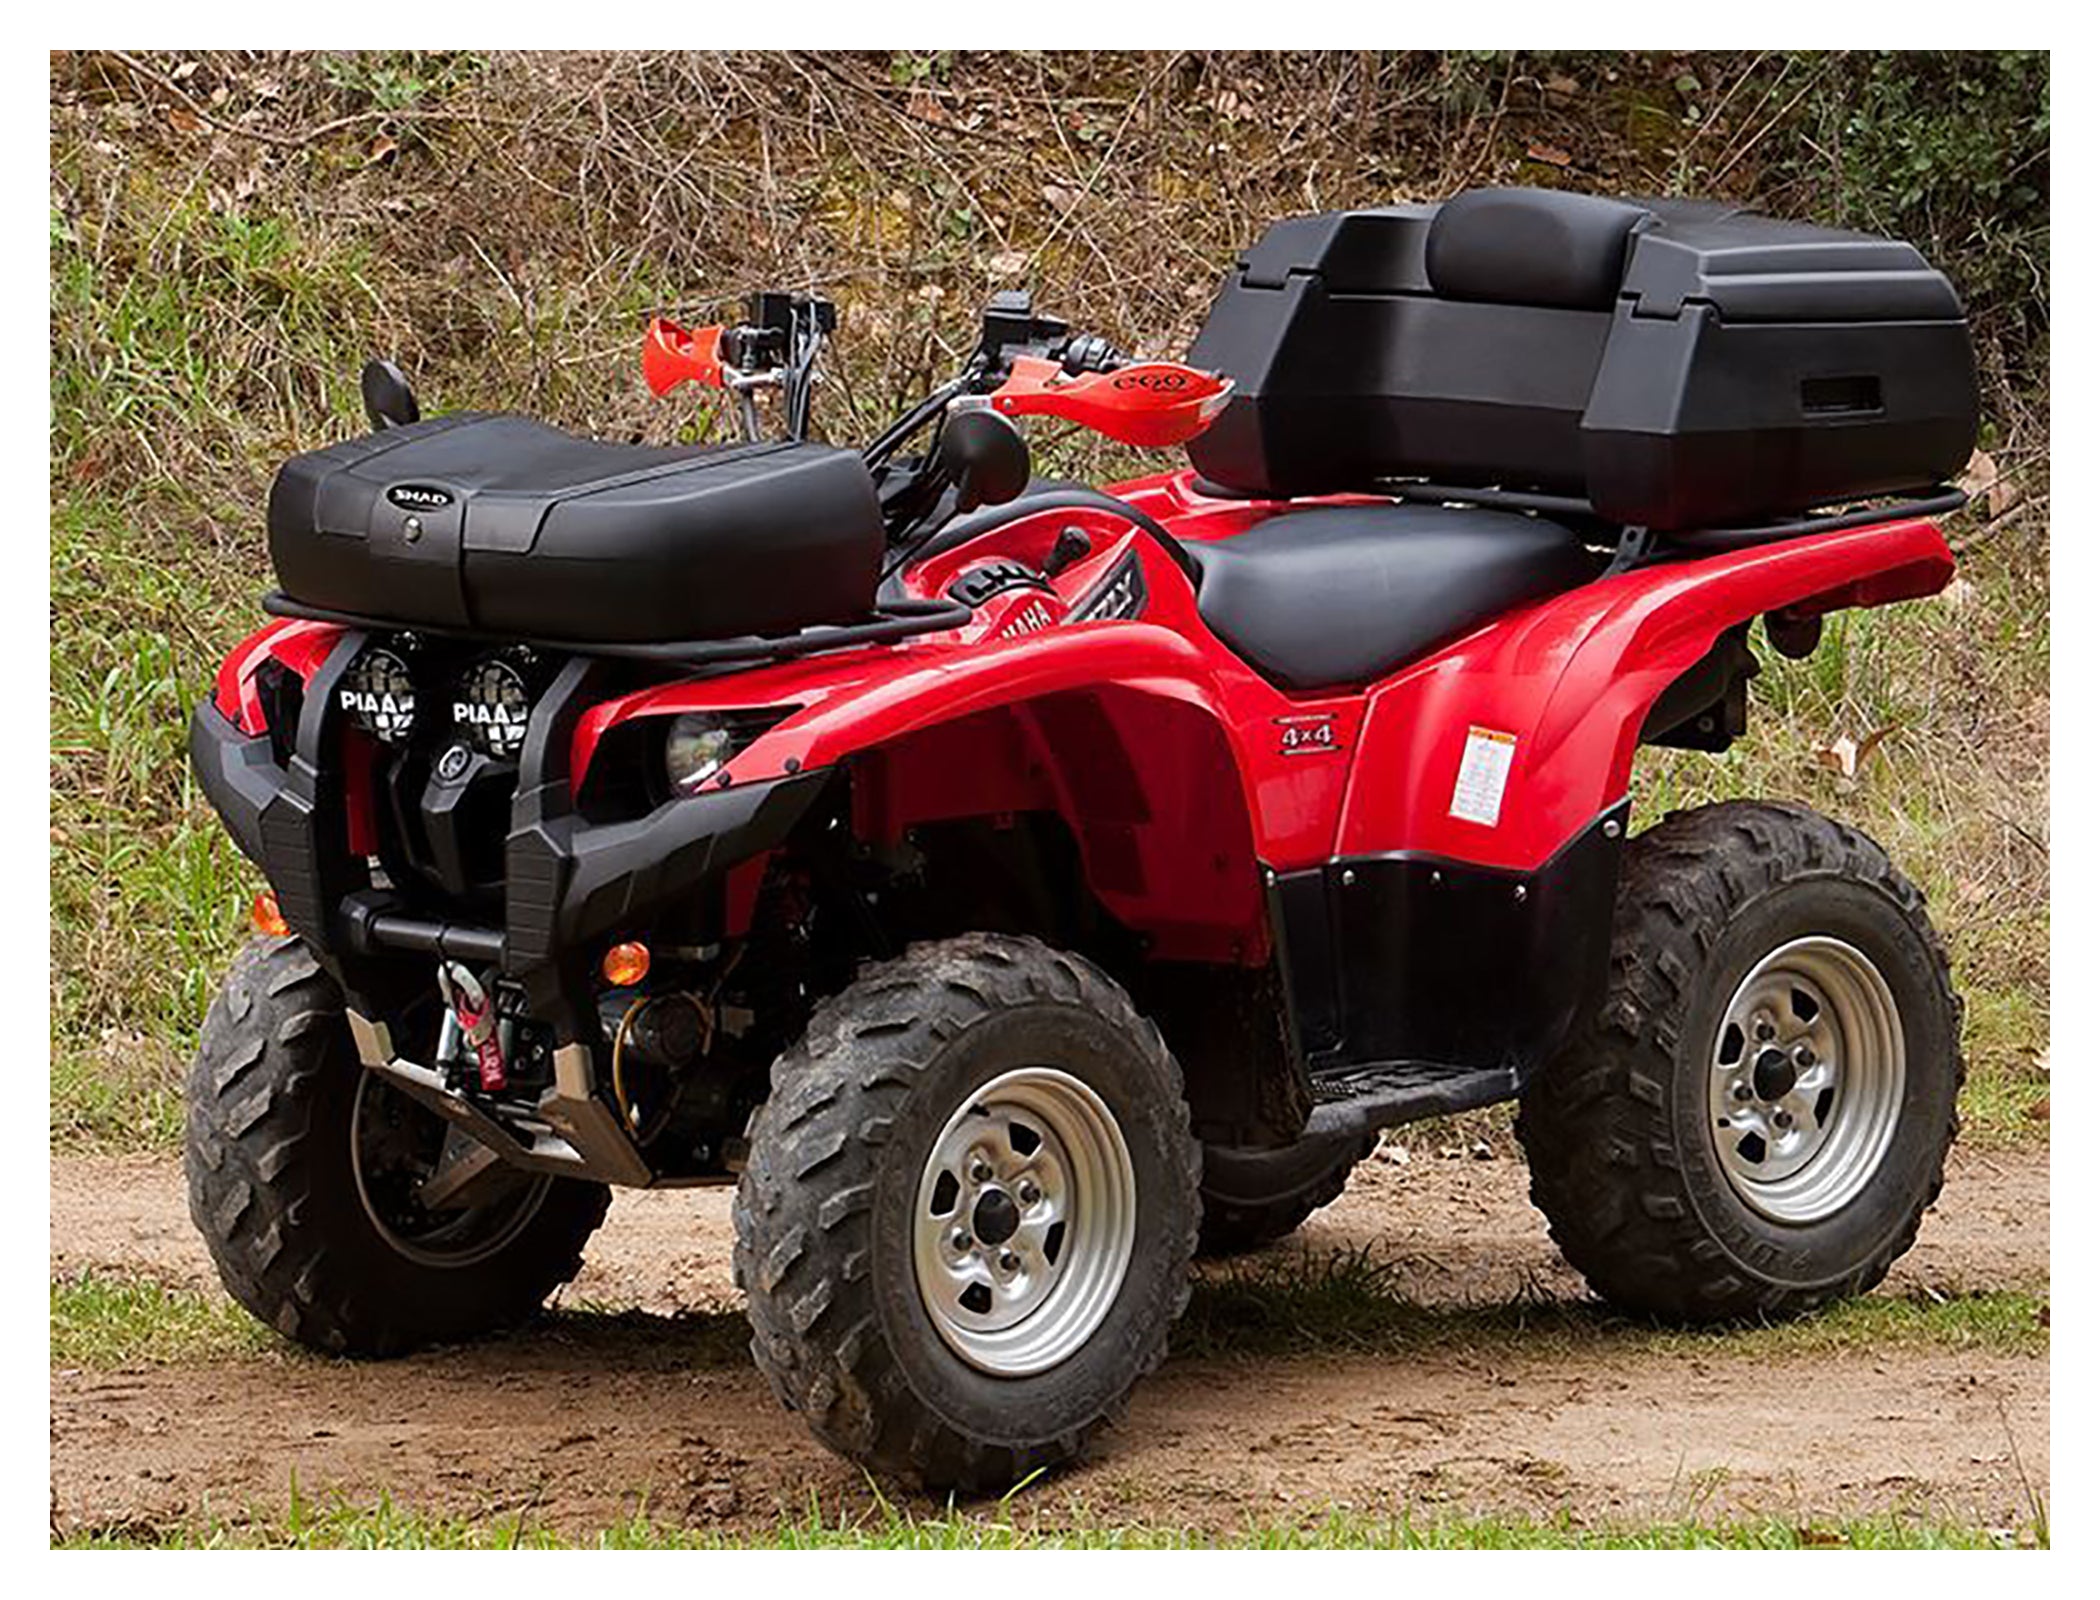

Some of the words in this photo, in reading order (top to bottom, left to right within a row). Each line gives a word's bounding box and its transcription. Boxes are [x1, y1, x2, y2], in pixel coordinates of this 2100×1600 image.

[394, 488, 448, 506] SHAD
[340, 691, 398, 713] PIAA
[453, 703, 511, 723] PIAA
[1281, 724, 1332, 747] 4x4
